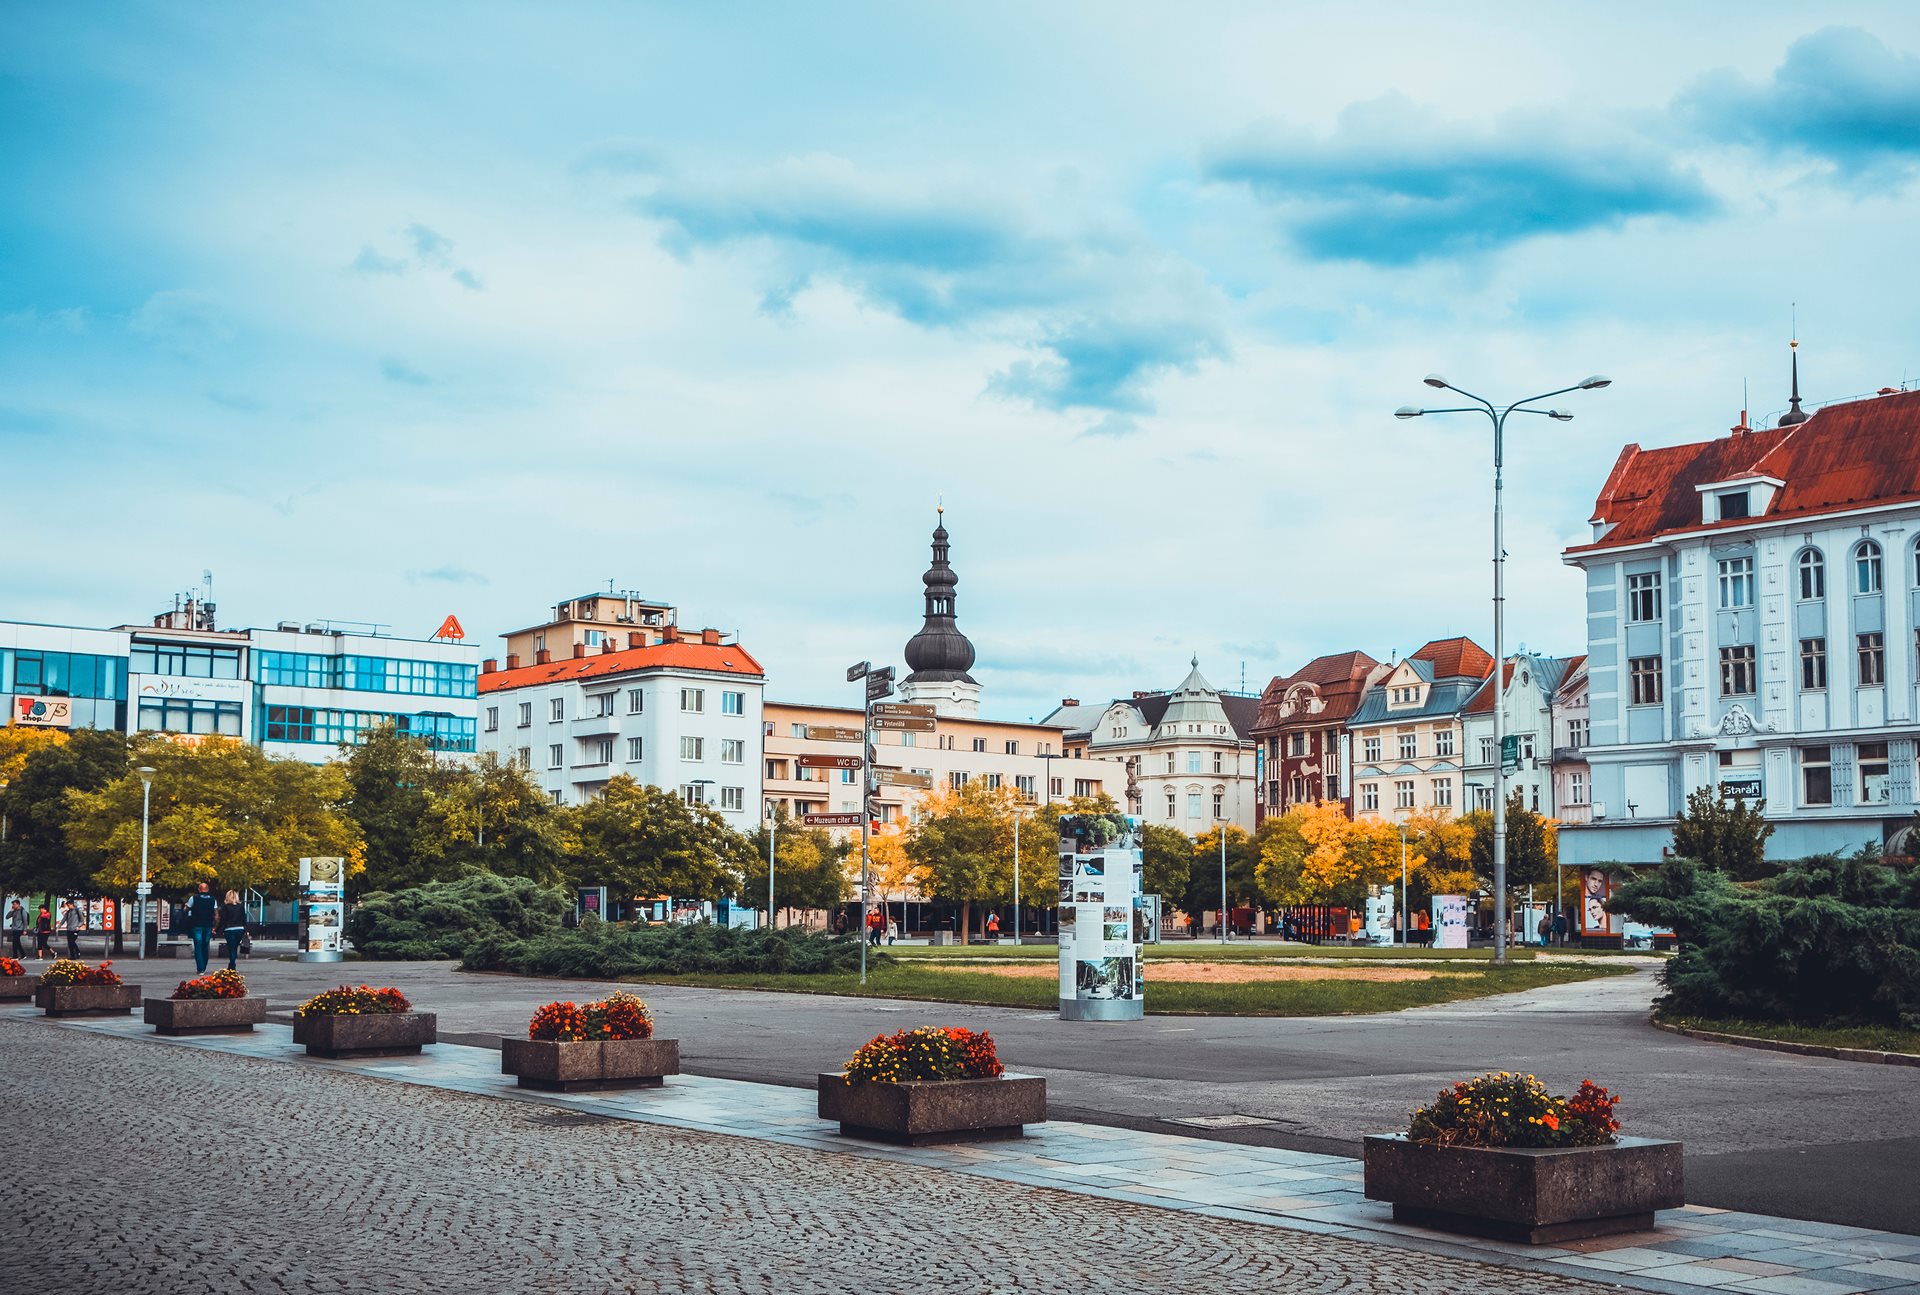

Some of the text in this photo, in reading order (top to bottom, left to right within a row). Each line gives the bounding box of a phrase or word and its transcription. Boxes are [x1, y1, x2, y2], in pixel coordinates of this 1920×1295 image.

[22, 714, 42, 723] shop
[837, 758, 850, 766] WC
[1723, 784, 1752, 795] Stará
[814, 816, 851, 825] Muzeum citer
